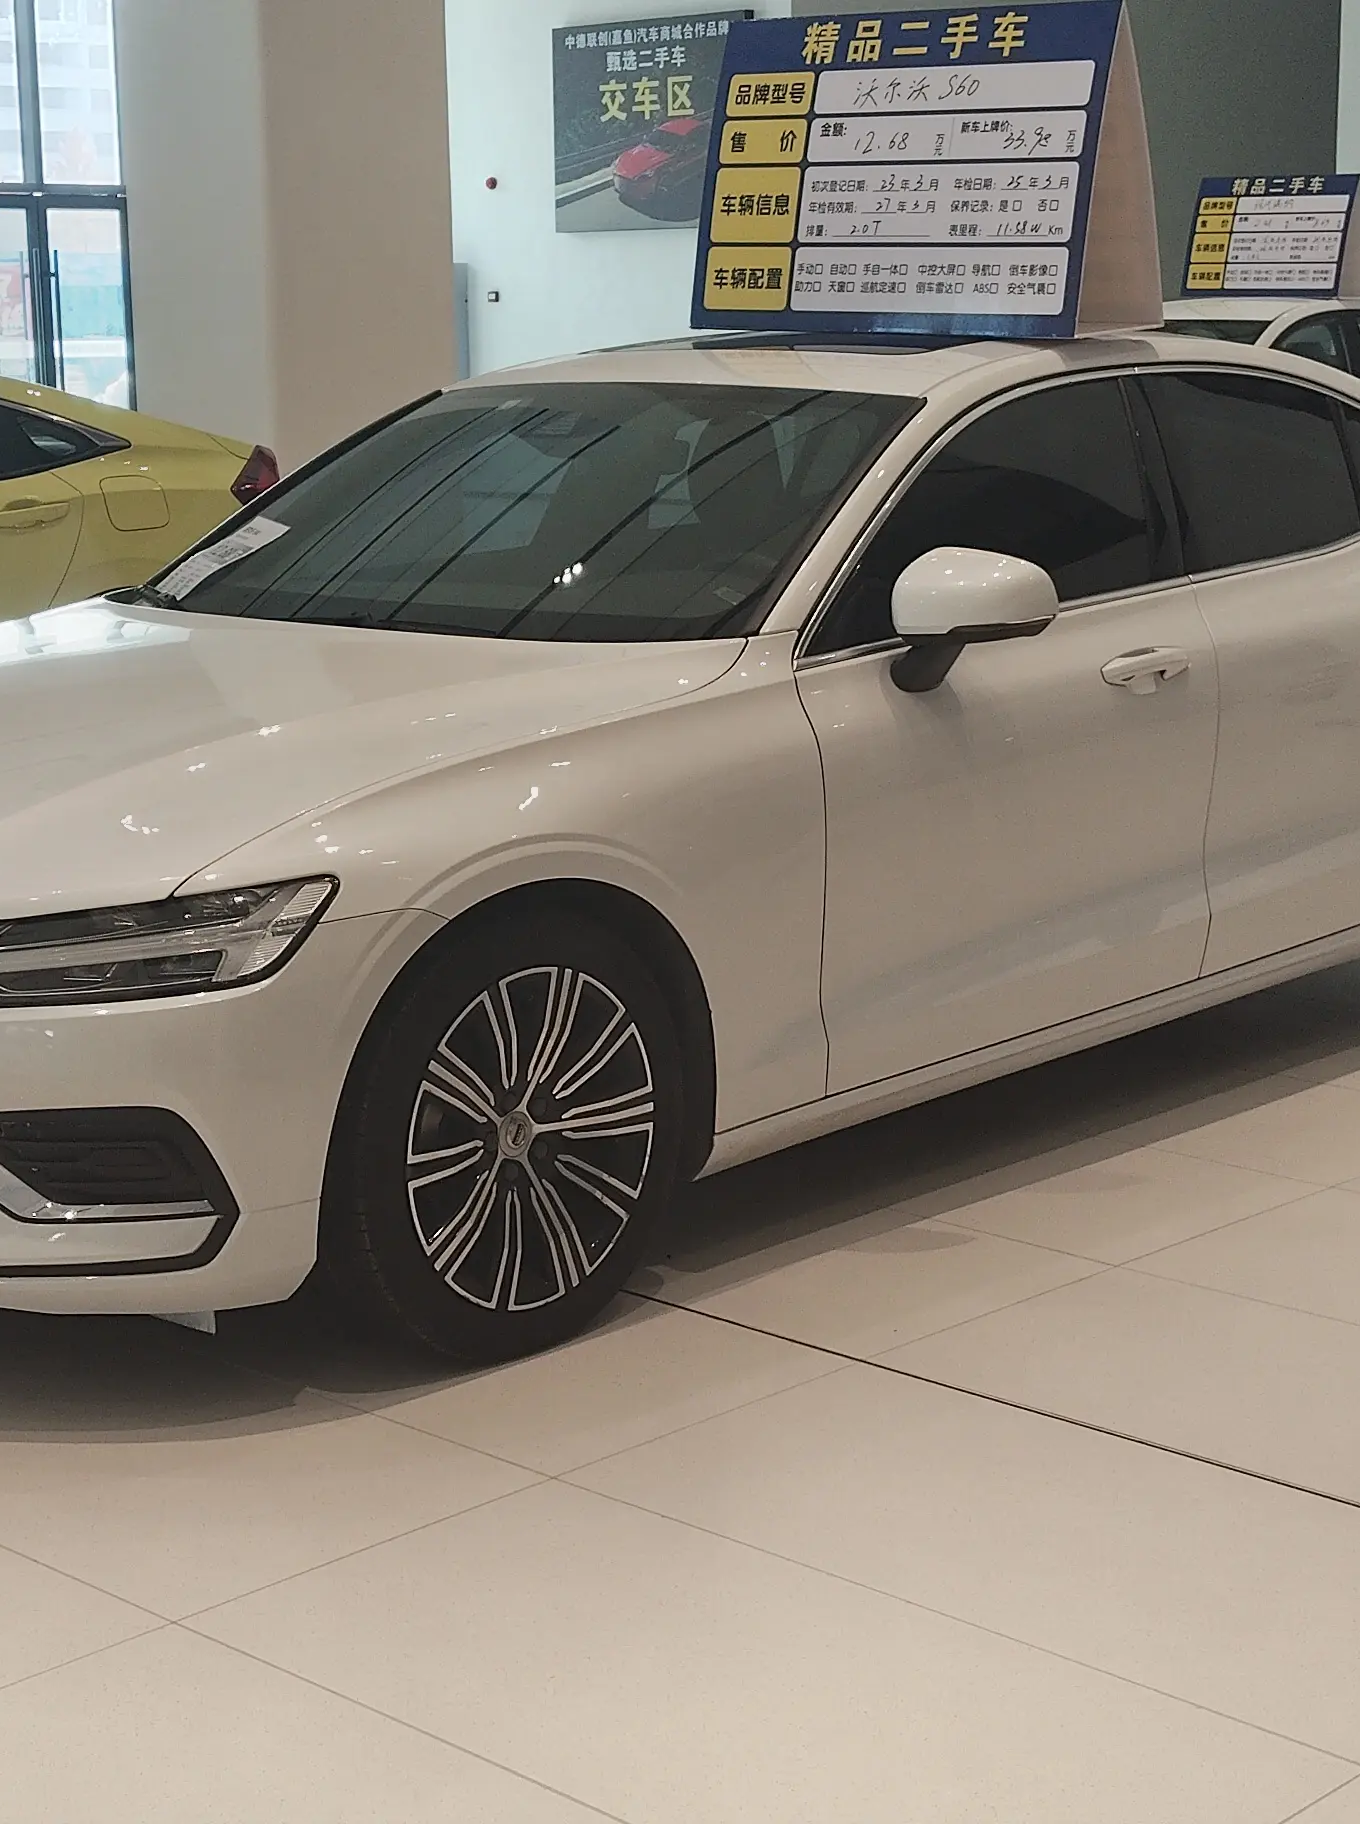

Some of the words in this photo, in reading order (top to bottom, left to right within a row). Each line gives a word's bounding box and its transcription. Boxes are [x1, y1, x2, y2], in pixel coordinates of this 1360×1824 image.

[801, 12, 1030, 66] 精品二手车
[606, 45, 686, 72] 甄选二手车
[599, 75, 695, 122] 交车区
[734, 81, 806, 105] 品牌型号
[853, 78, 929, 108] 沃尔沃
[939, 78, 980, 99] S60
[855, 131, 909, 155] 12.68
[1232, 176, 1325, 196] 精品二手车
[720, 194, 789, 217] 车辆信息
[713, 267, 783, 290] 车辆配置
